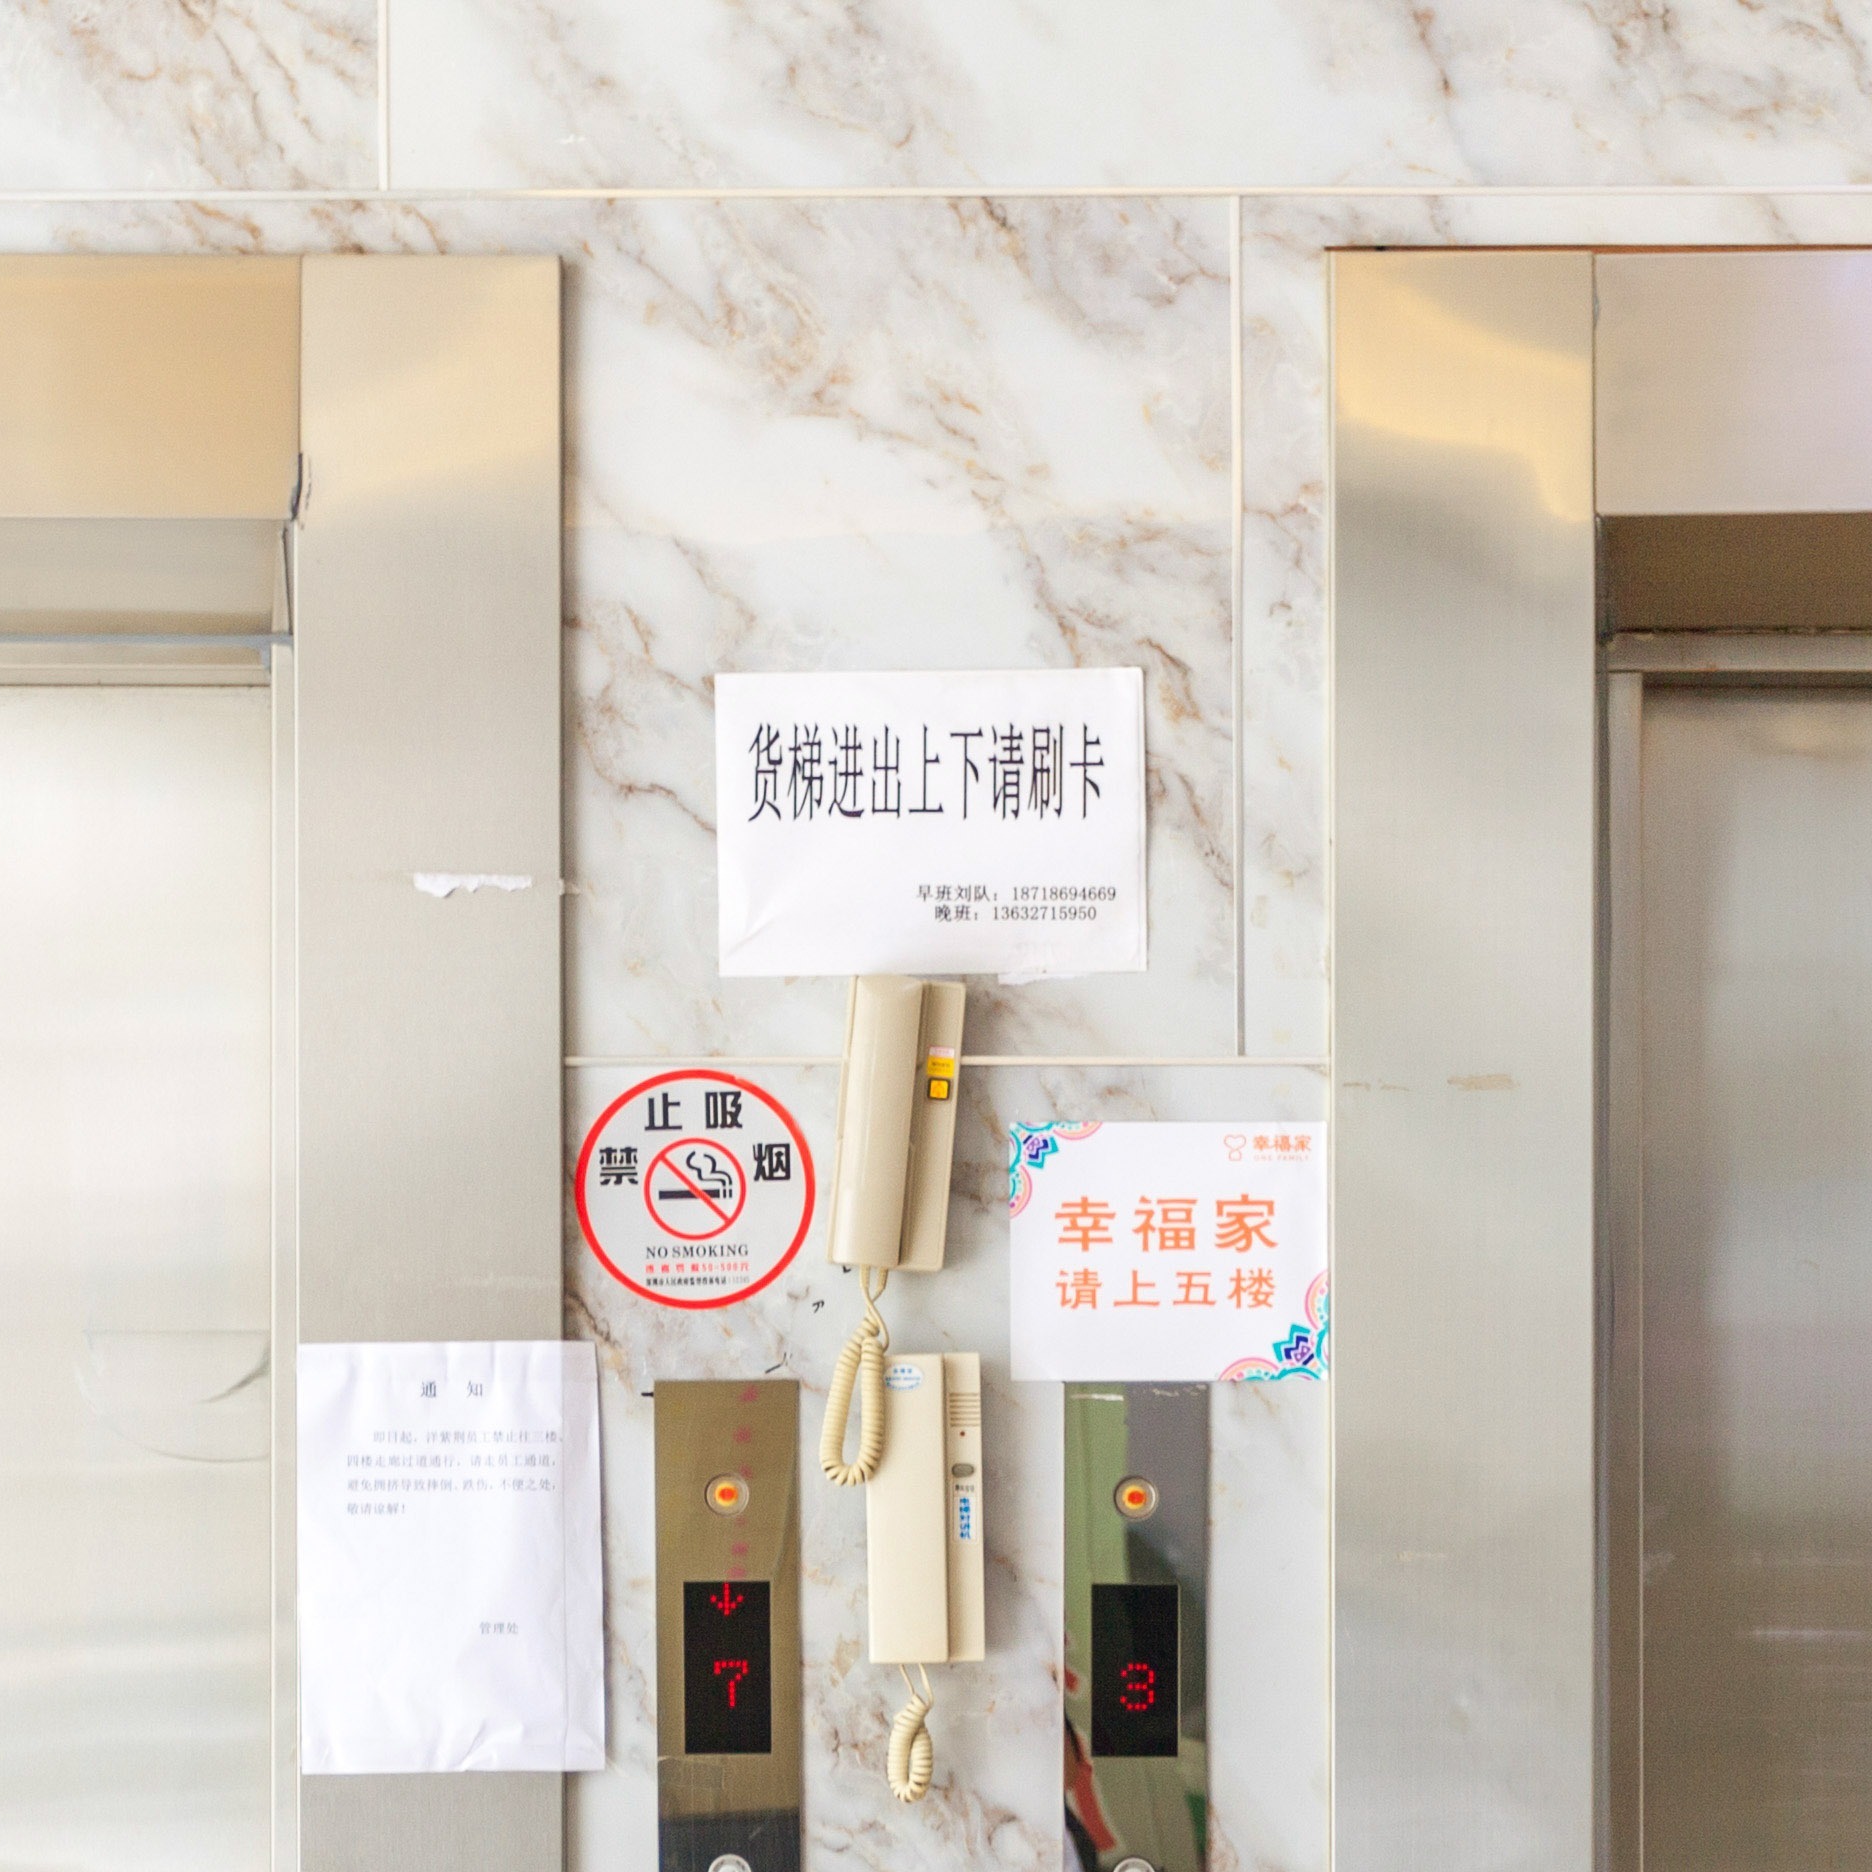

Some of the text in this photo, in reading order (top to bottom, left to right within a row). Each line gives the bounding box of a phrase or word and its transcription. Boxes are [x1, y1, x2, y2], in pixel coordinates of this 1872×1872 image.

[748, 723, 1105, 822] 货梯进出上下请刷卡
[1253, 1135, 1312, 1152] 幸福家
[1054, 1193, 1278, 1253] 幸福家
[646, 1244, 748, 1259] NO SMOKING
[1055, 1267, 1276, 1310] 请上五楼
[420, 1380, 484, 1398] 通知
[479, 1621, 519, 1635] 管理处
[714, 1660, 748, 1708] 7
[1120, 1663, 1155, 1710] 3
